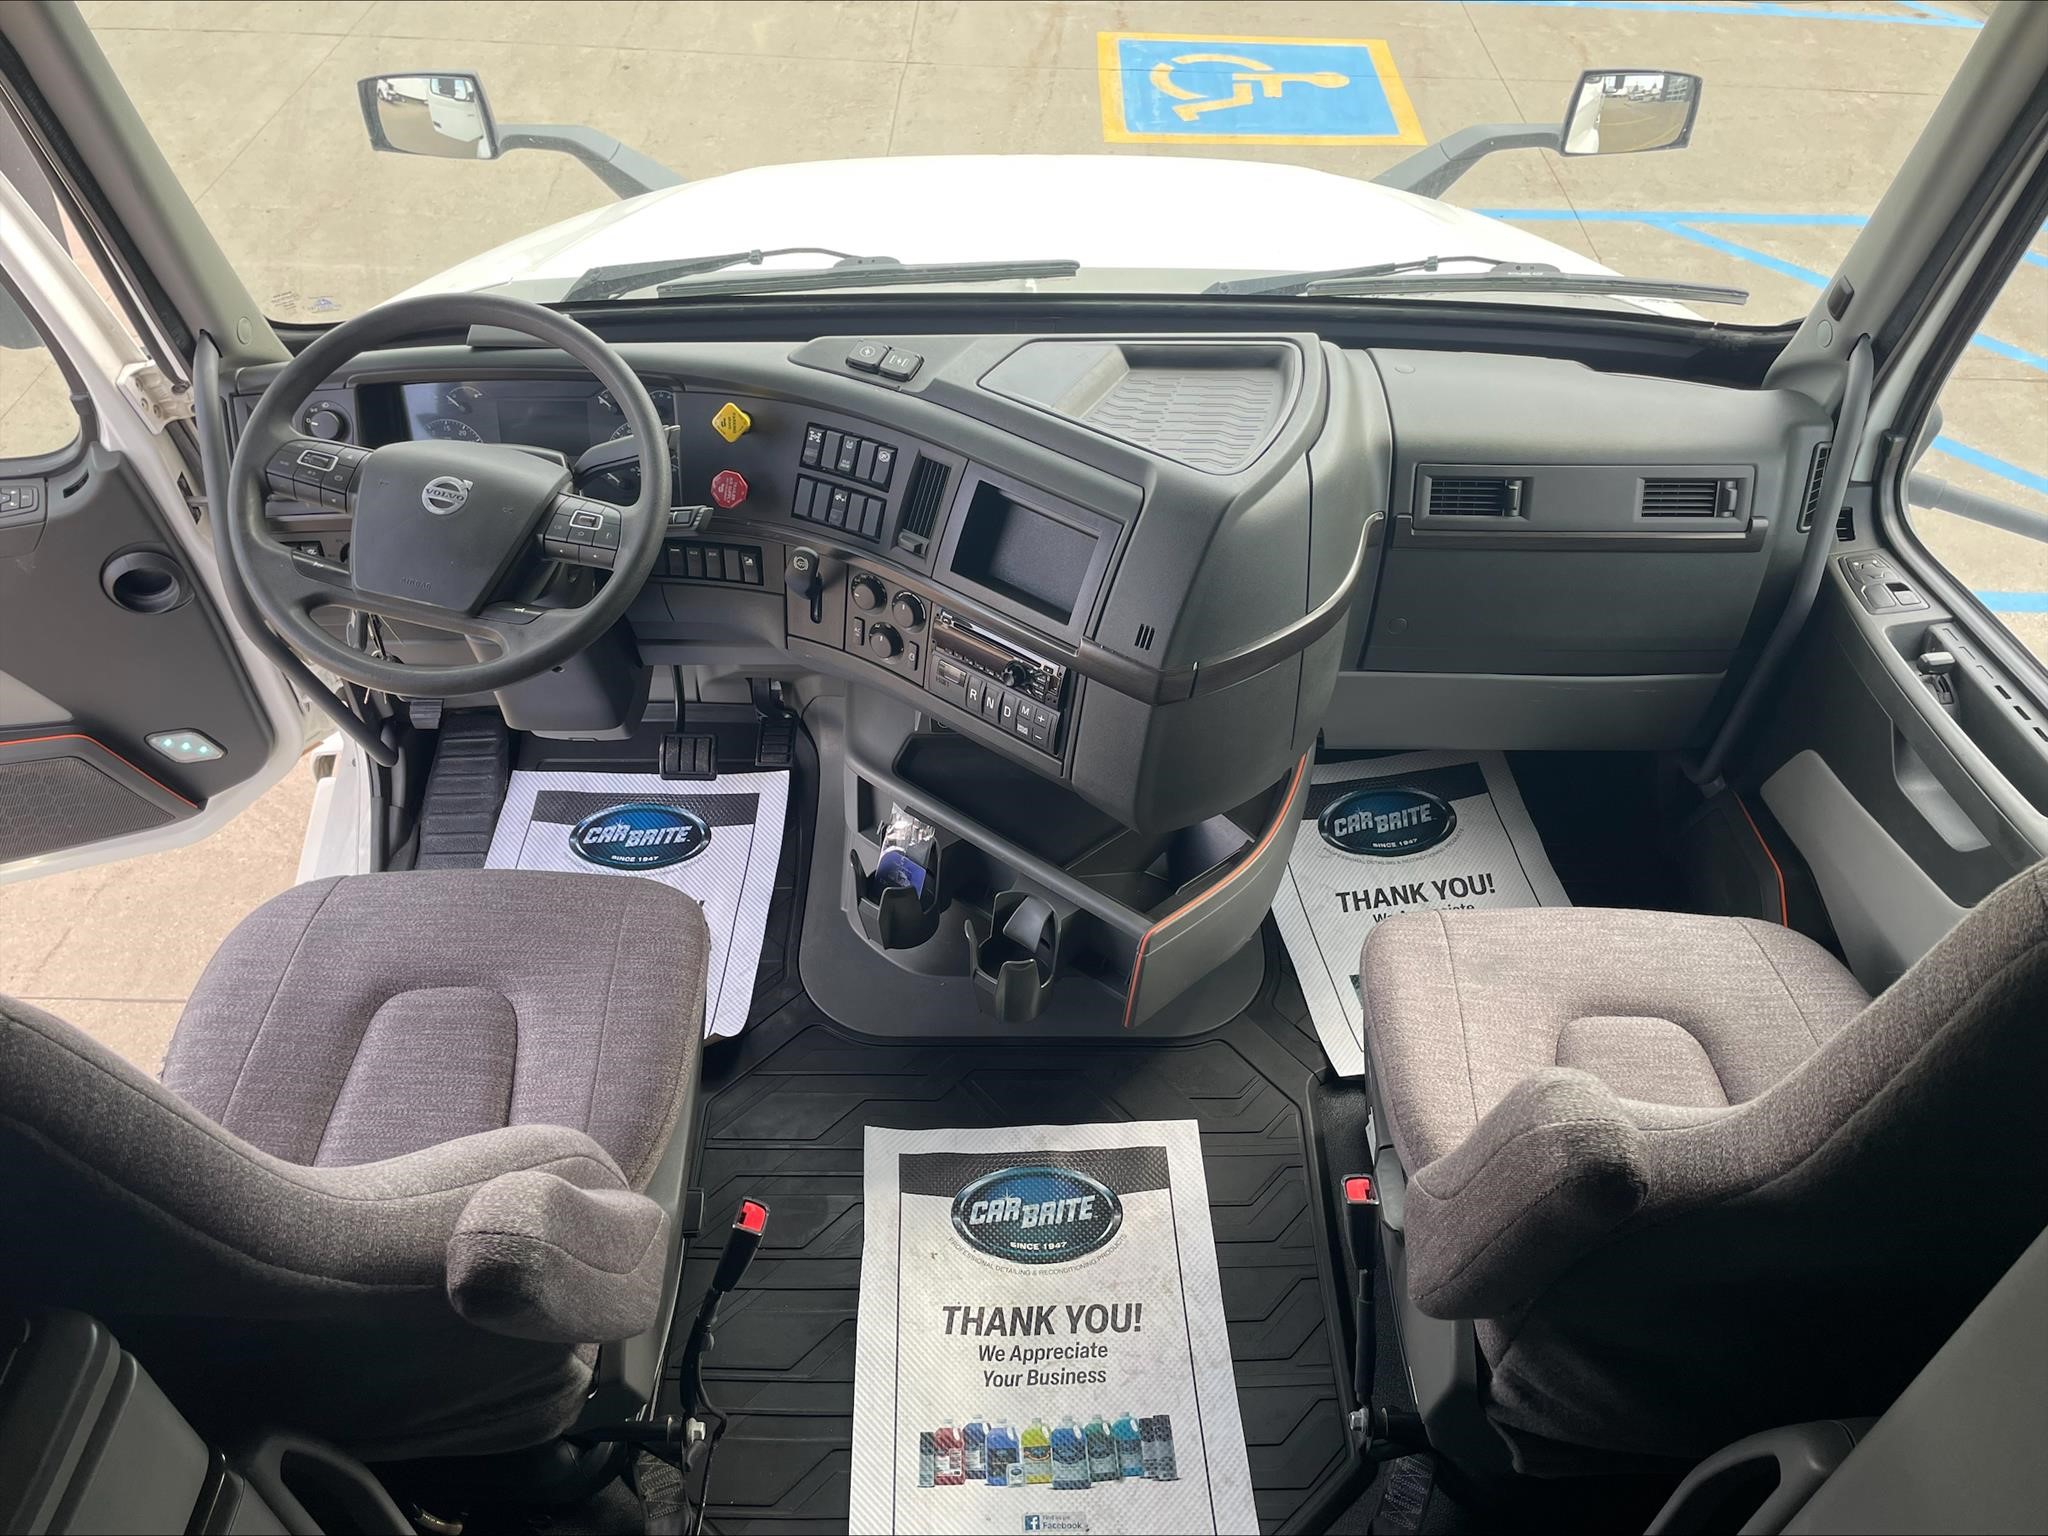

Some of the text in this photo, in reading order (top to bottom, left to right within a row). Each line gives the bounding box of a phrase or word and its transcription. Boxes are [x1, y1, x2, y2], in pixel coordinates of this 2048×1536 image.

[426, 488, 465, 501] VOLVO
[969, 689, 978, 701] R
[986, 697, 995, 709] N
[1003, 706, 1011, 718] D
[1021, 705, 1030, 716] M
[1333, 803, 1432, 837] CAR BRITE
[583, 824, 692, 848] CAR BRITE
[1399, 838, 1418, 847] 1947
[1335, 873, 1496, 913] THANK YOU!
[969, 1195, 1096, 1229] CAR BRITE
[1009, 1241, 1068, 1251] SINCE 1947
[995, 1265, 1030, 1276] DETAILING
[942, 1303, 1143, 1337] THANK YOU!
[978, 1342, 1108, 1365] We Appreciate
[983, 1367, 1107, 1387] Your Business
[1042, 1521, 1082, 1529] Facebook
